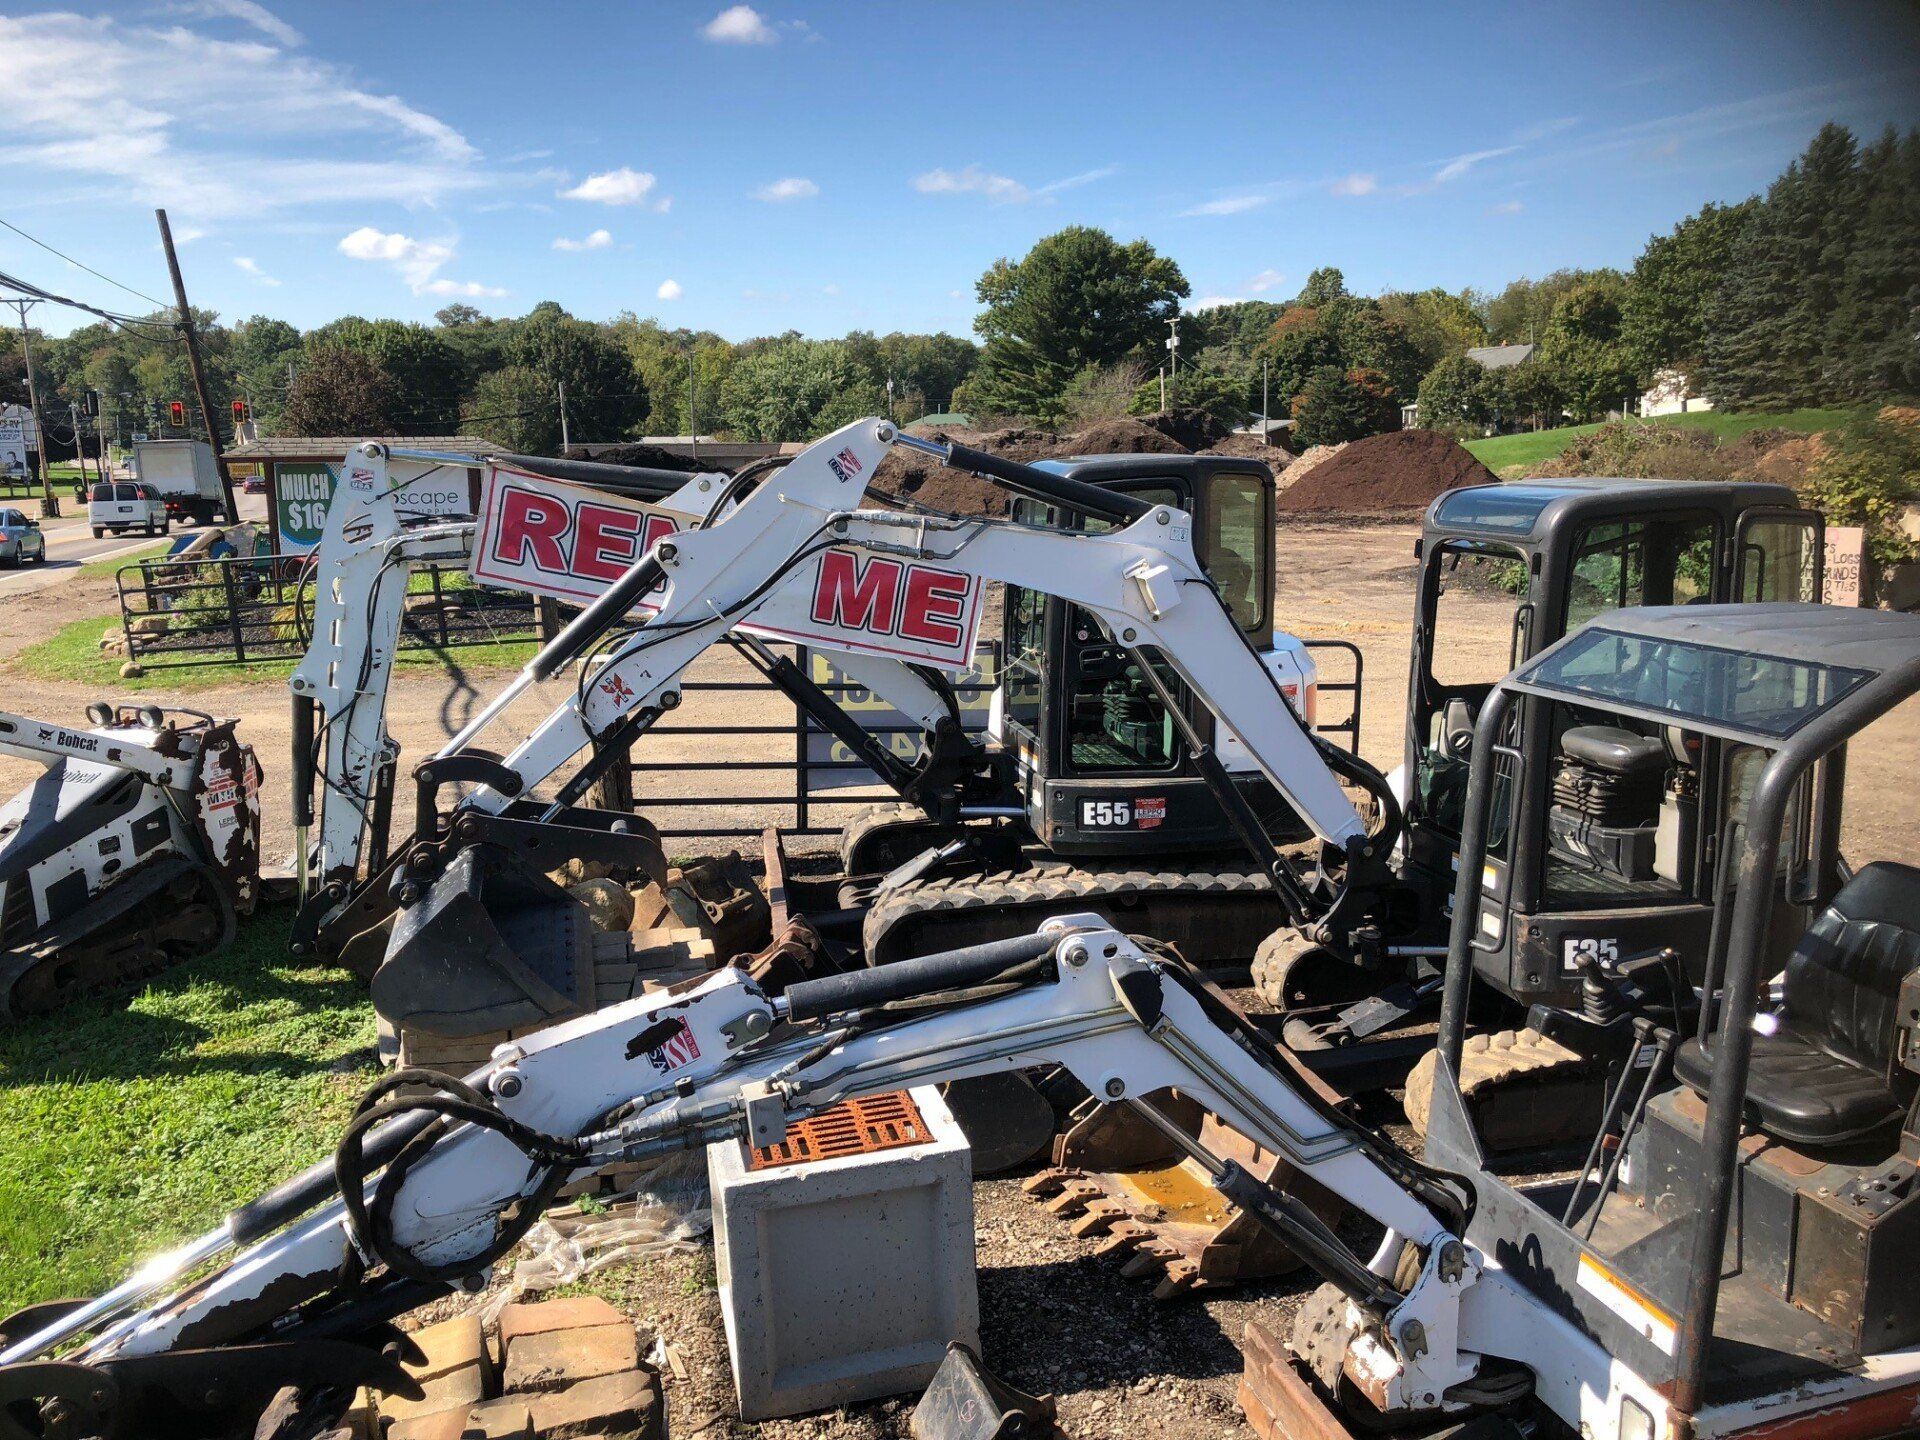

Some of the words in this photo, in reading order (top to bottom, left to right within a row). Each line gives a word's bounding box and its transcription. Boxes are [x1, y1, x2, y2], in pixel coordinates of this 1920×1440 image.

[829, 459, 847, 482] USA
[280, 473, 330, 501] MULCH
[288, 502, 327, 532] $16
[490, 485, 702, 595] RE
[809, 548, 971, 648] ME
[57, 731, 99, 751] Bobcat
[1083, 801, 1130, 825] E55
[1564, 938, 1618, 970] E35
[650, 1047, 667, 1071] SA
